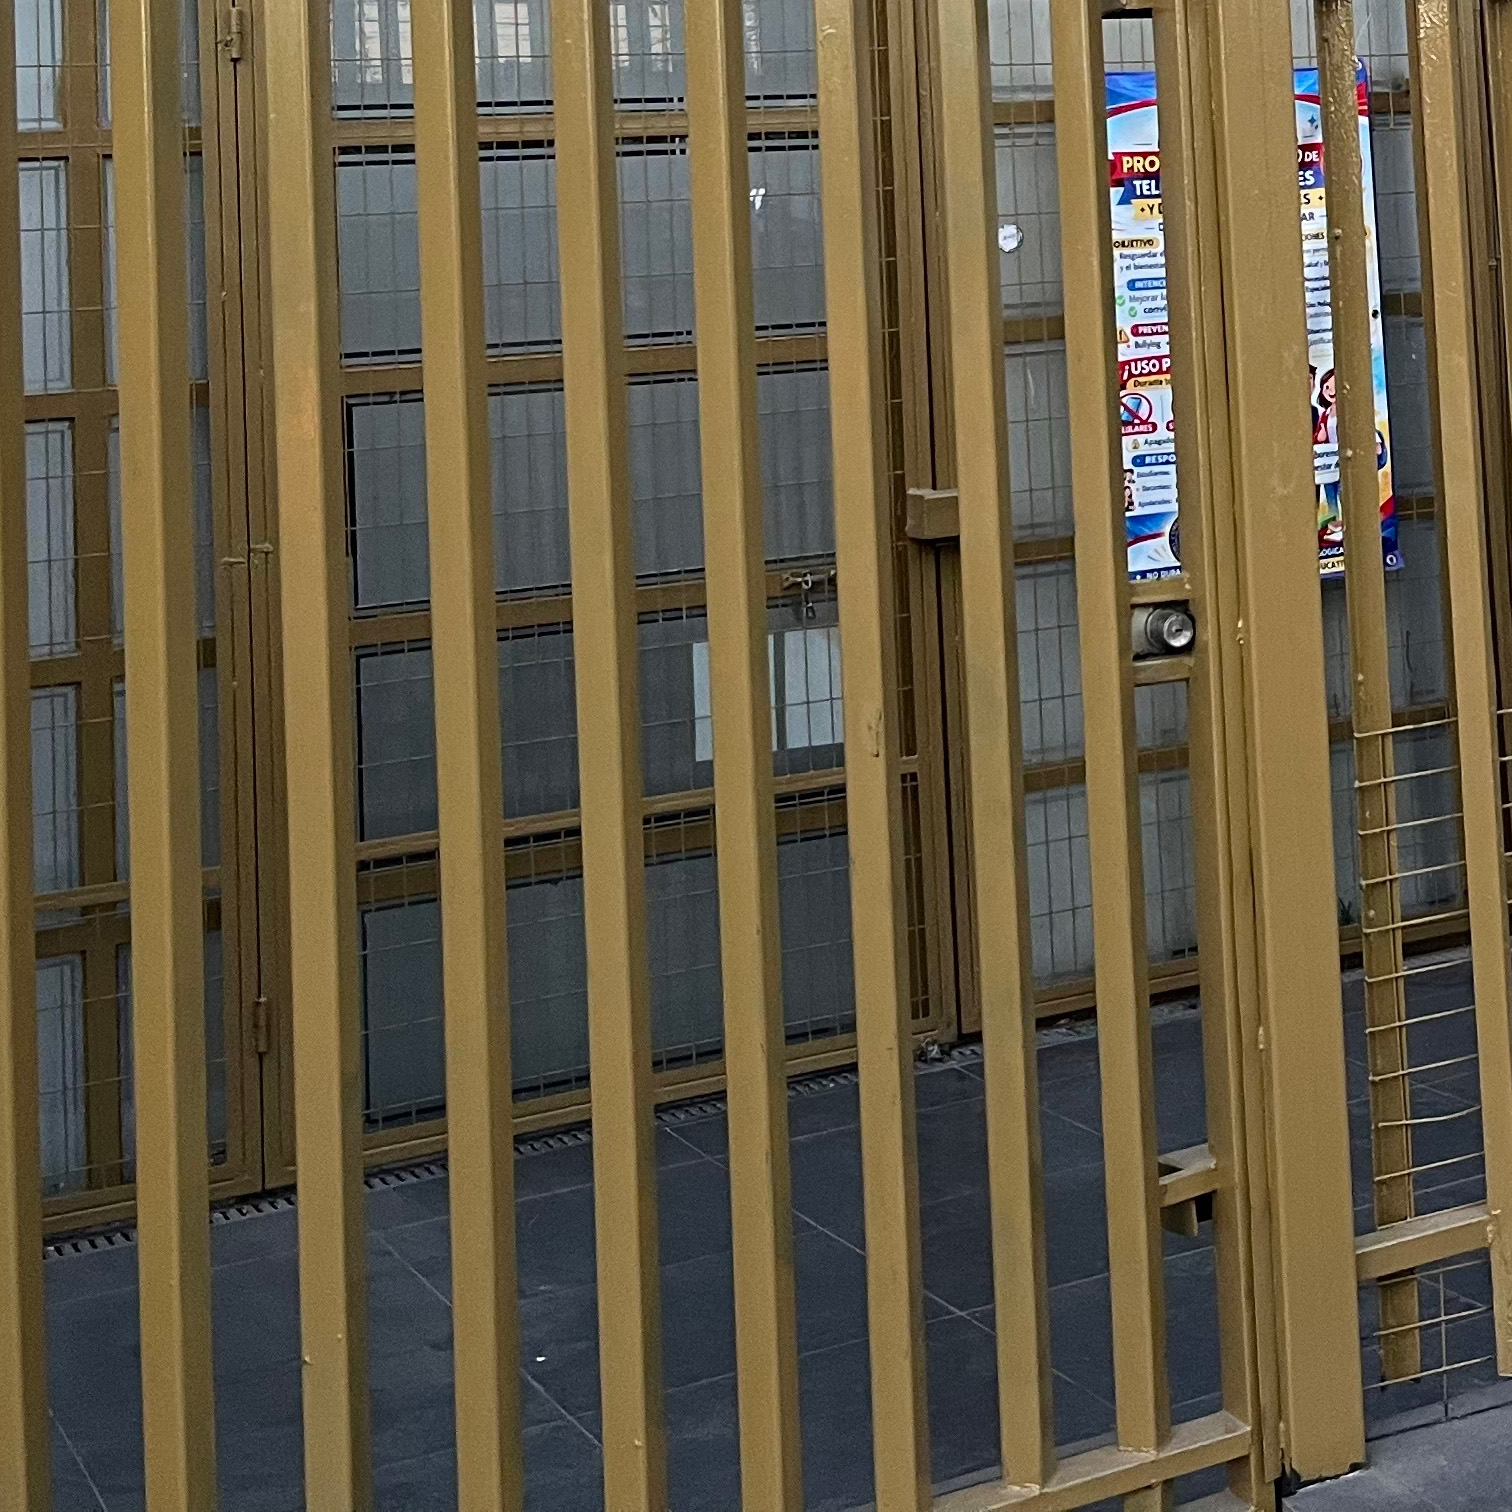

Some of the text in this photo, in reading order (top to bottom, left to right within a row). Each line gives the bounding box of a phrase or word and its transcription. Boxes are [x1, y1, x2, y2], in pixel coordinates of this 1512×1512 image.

[1304, 150, 1320, 162] DE
[1138, 325, 1169, 334] PREVEN
[1122, 359, 1160, 381] ¡USO
[1145, 454, 1177, 464] RESPO
